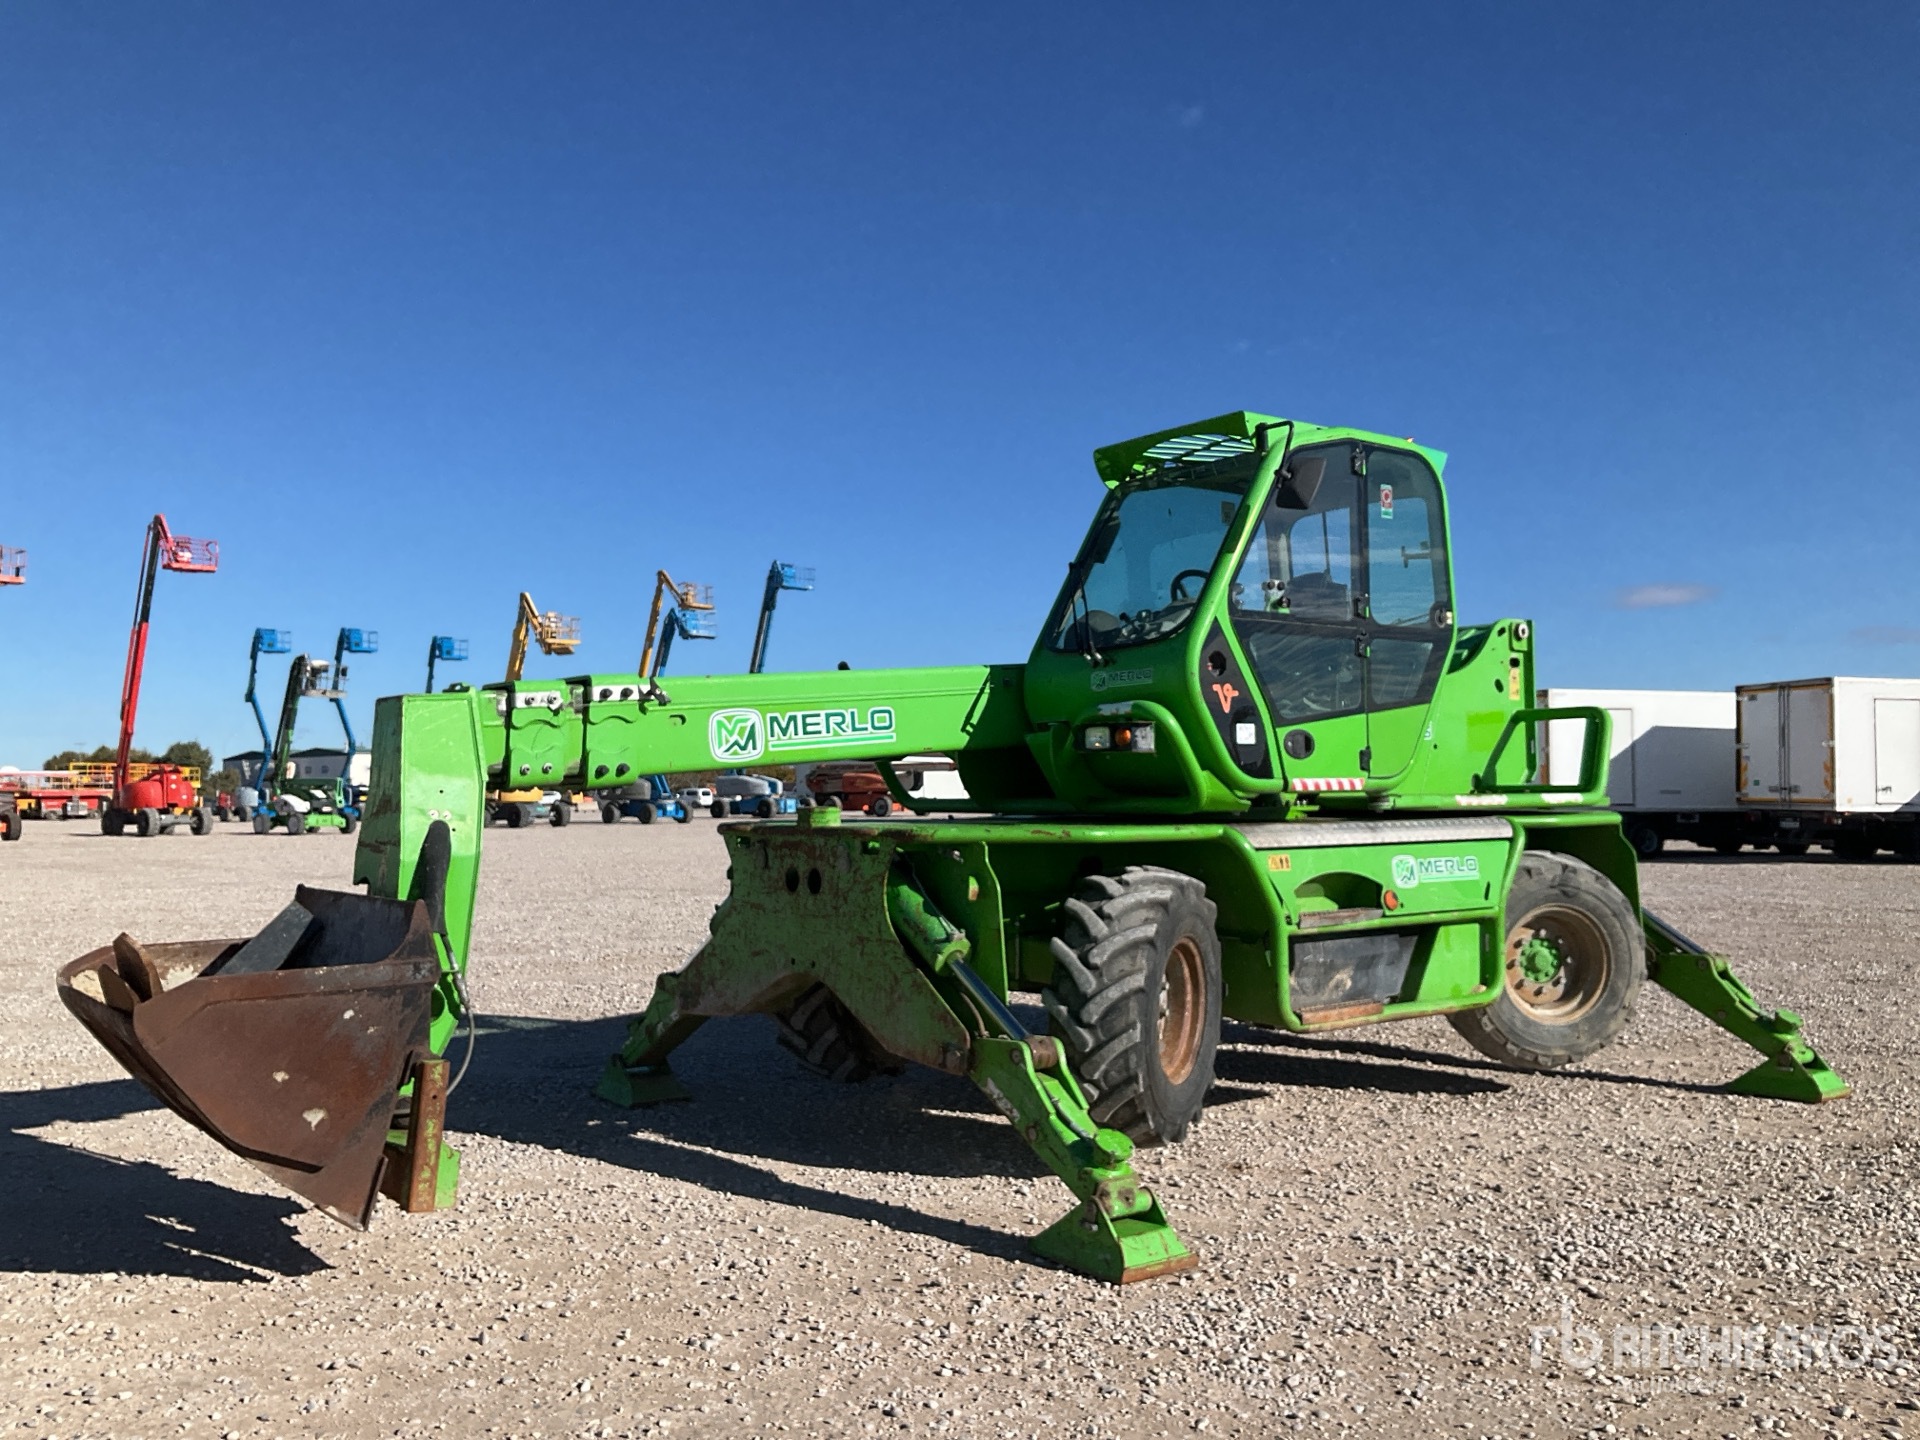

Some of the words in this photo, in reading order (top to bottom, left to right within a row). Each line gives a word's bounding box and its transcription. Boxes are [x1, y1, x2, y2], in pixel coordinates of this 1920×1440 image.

[1108, 669, 1152, 682] MERLO
[769, 708, 893, 738] MERLO
[1419, 858, 1477, 873] MERLO
